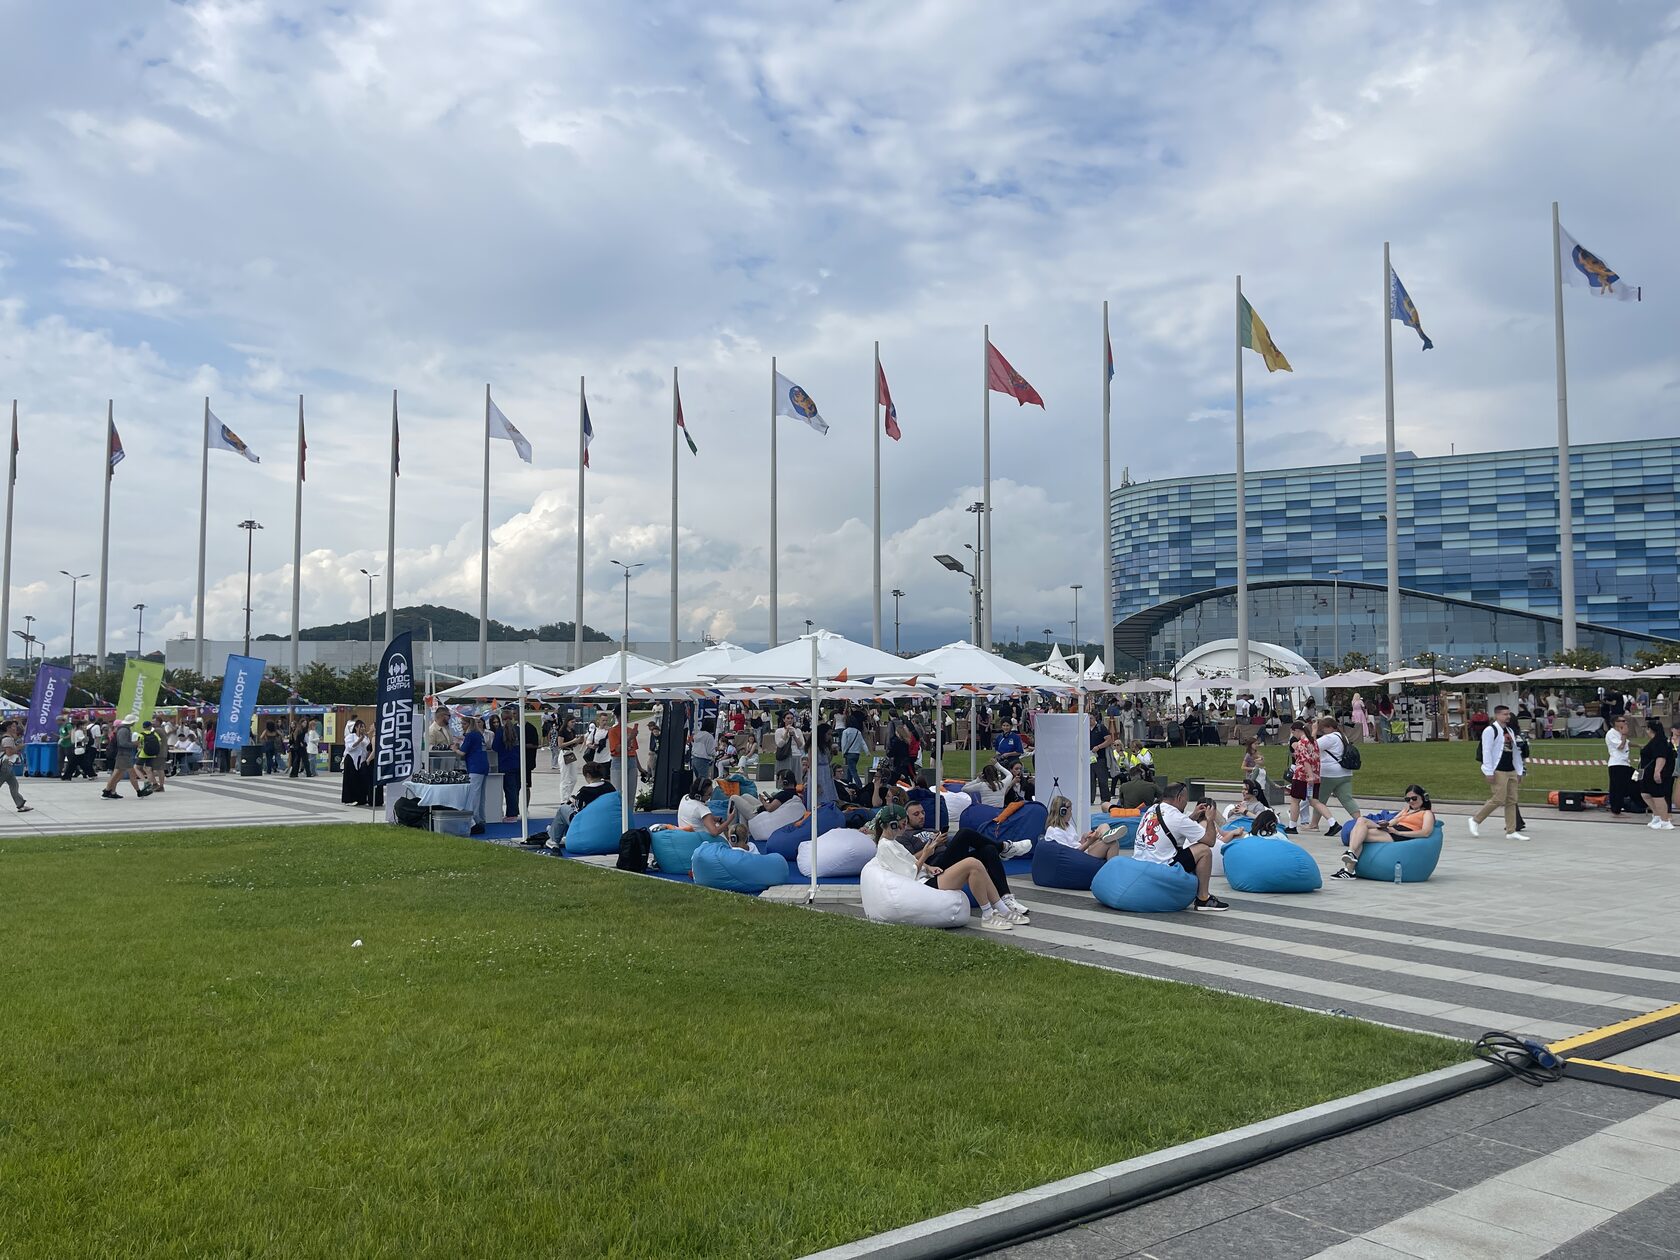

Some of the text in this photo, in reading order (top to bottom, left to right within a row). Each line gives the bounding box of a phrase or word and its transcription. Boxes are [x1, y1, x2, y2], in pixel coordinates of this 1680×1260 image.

[40, 677, 57, 725] ФУДКОРТ
[132, 673, 147, 720] УДКОРТ
[230, 669, 248, 723] ФУДКОРТ
[387, 675, 410, 685] ГОЛОС
[387, 682, 410, 692] ВНУТРИ
[377, 700, 396, 781] ГОЛОС
[395, 699, 412, 777] ВНУТРИ
